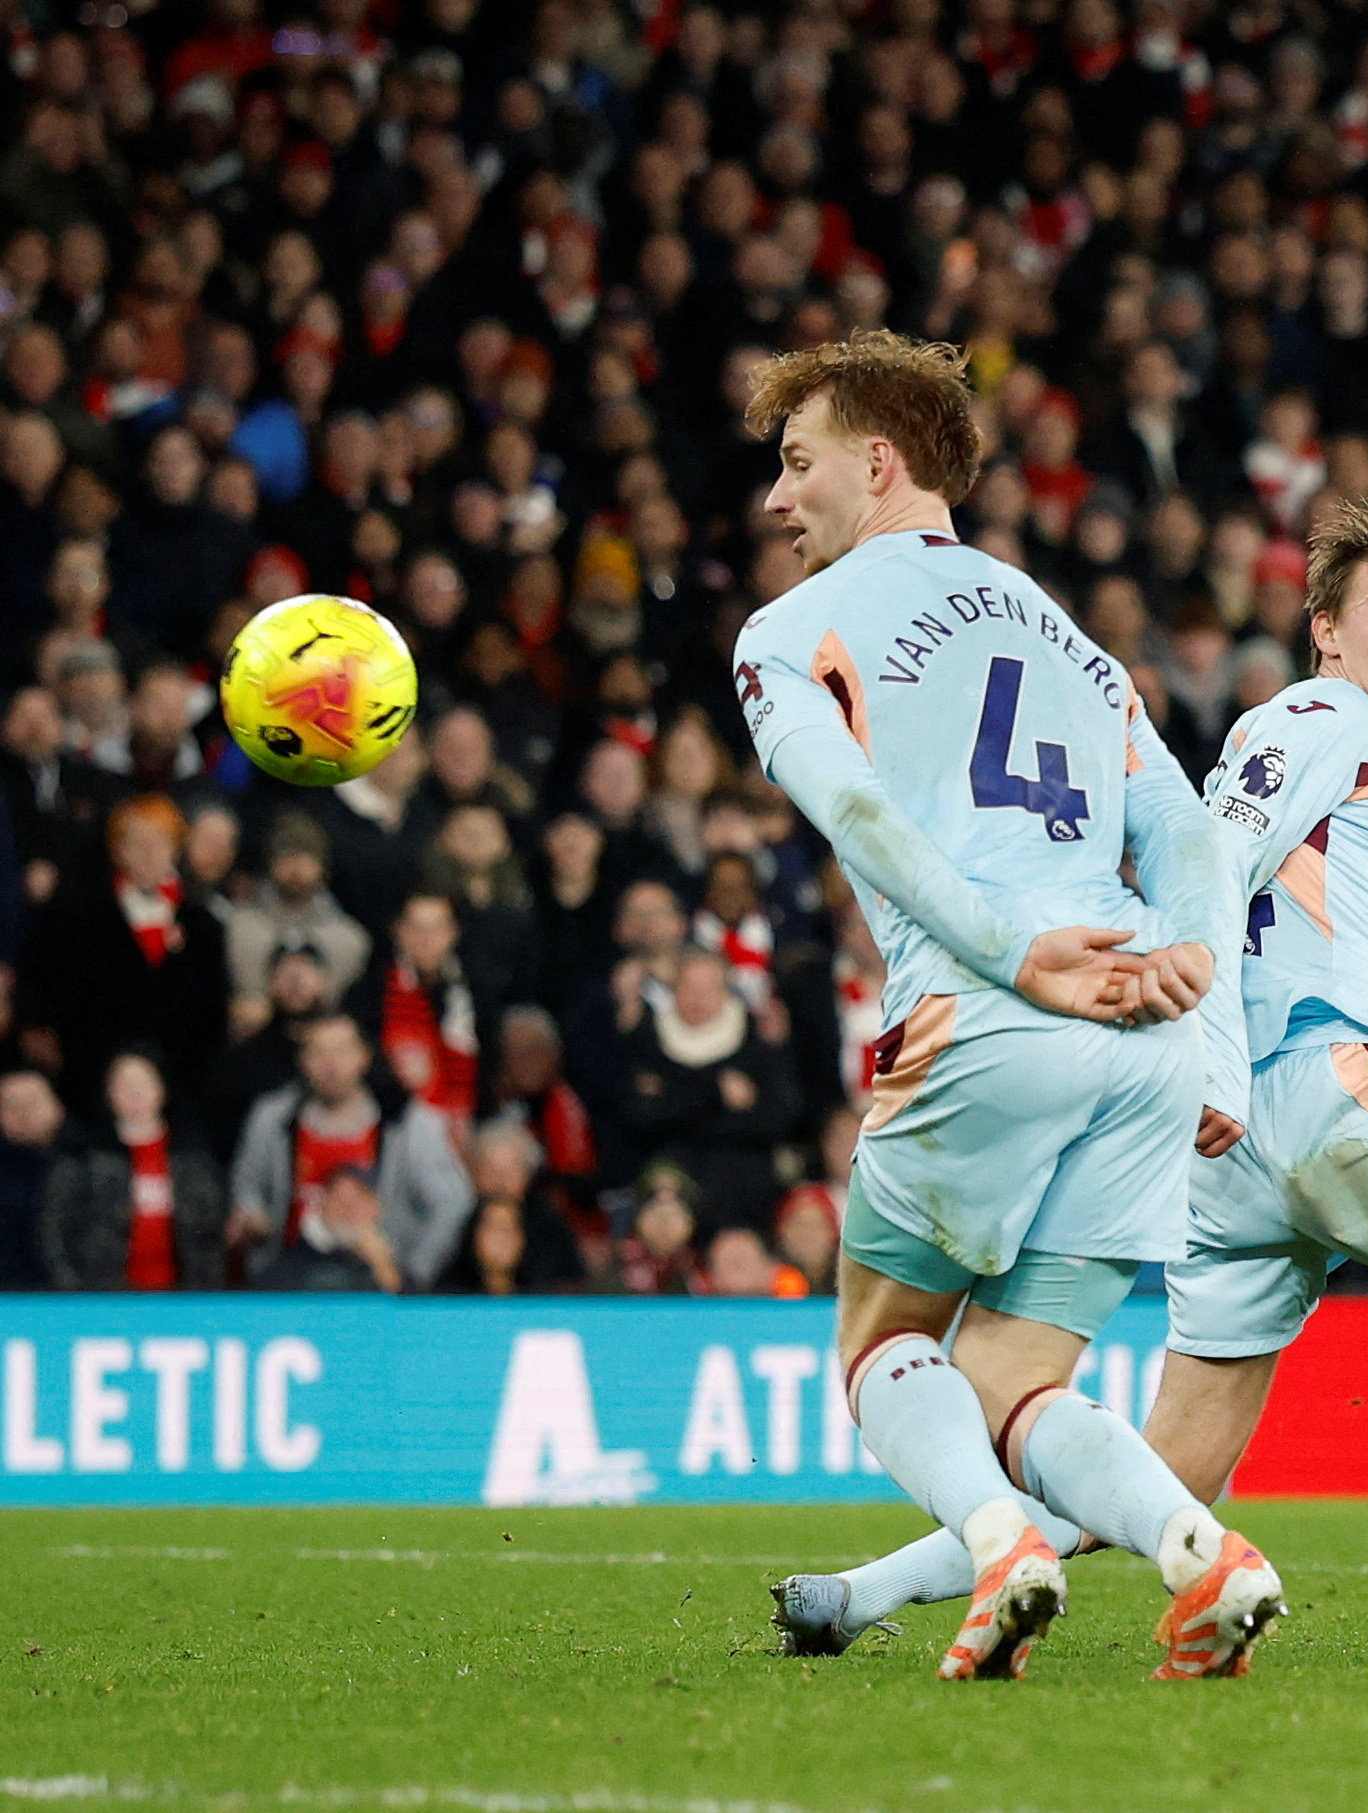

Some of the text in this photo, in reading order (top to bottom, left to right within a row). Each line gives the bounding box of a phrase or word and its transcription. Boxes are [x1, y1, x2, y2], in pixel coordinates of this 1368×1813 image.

[878, 586, 1122, 711] VAN DEN BERG
[968, 655, 1092, 843] 4
[1232, 800, 1266, 825] room
[3, 1336, 322, 1475] LETIC
[889, 1355, 958, 1381] BEE
